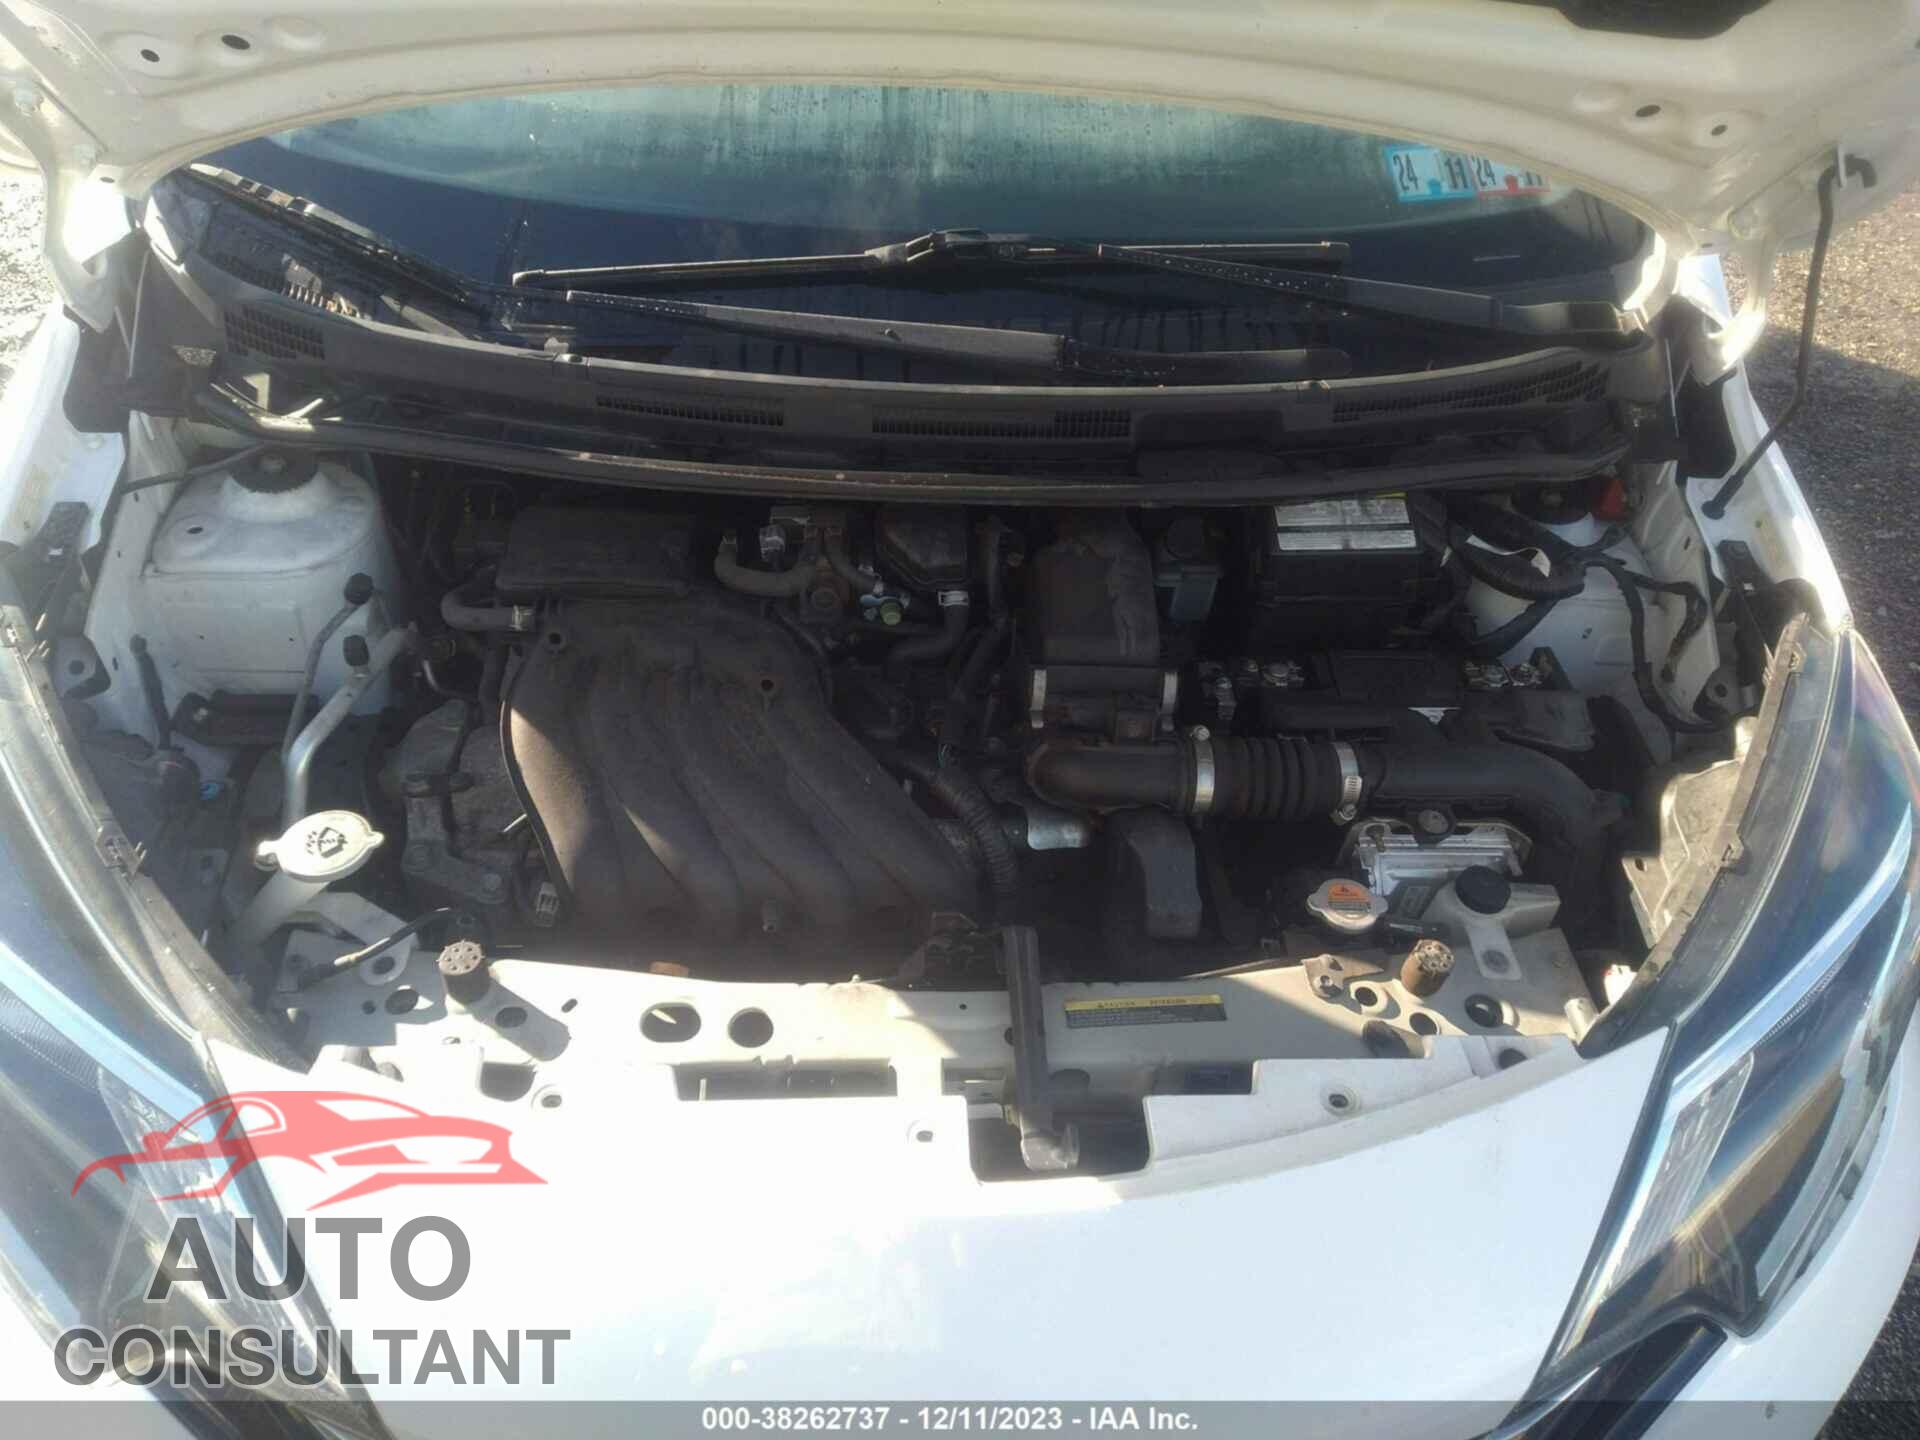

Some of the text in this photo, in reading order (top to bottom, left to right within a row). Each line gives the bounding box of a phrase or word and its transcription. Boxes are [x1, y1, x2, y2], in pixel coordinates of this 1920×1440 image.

[1393, 153, 1469, 191] 24 11
[1471, 154, 1498, 187] 24
